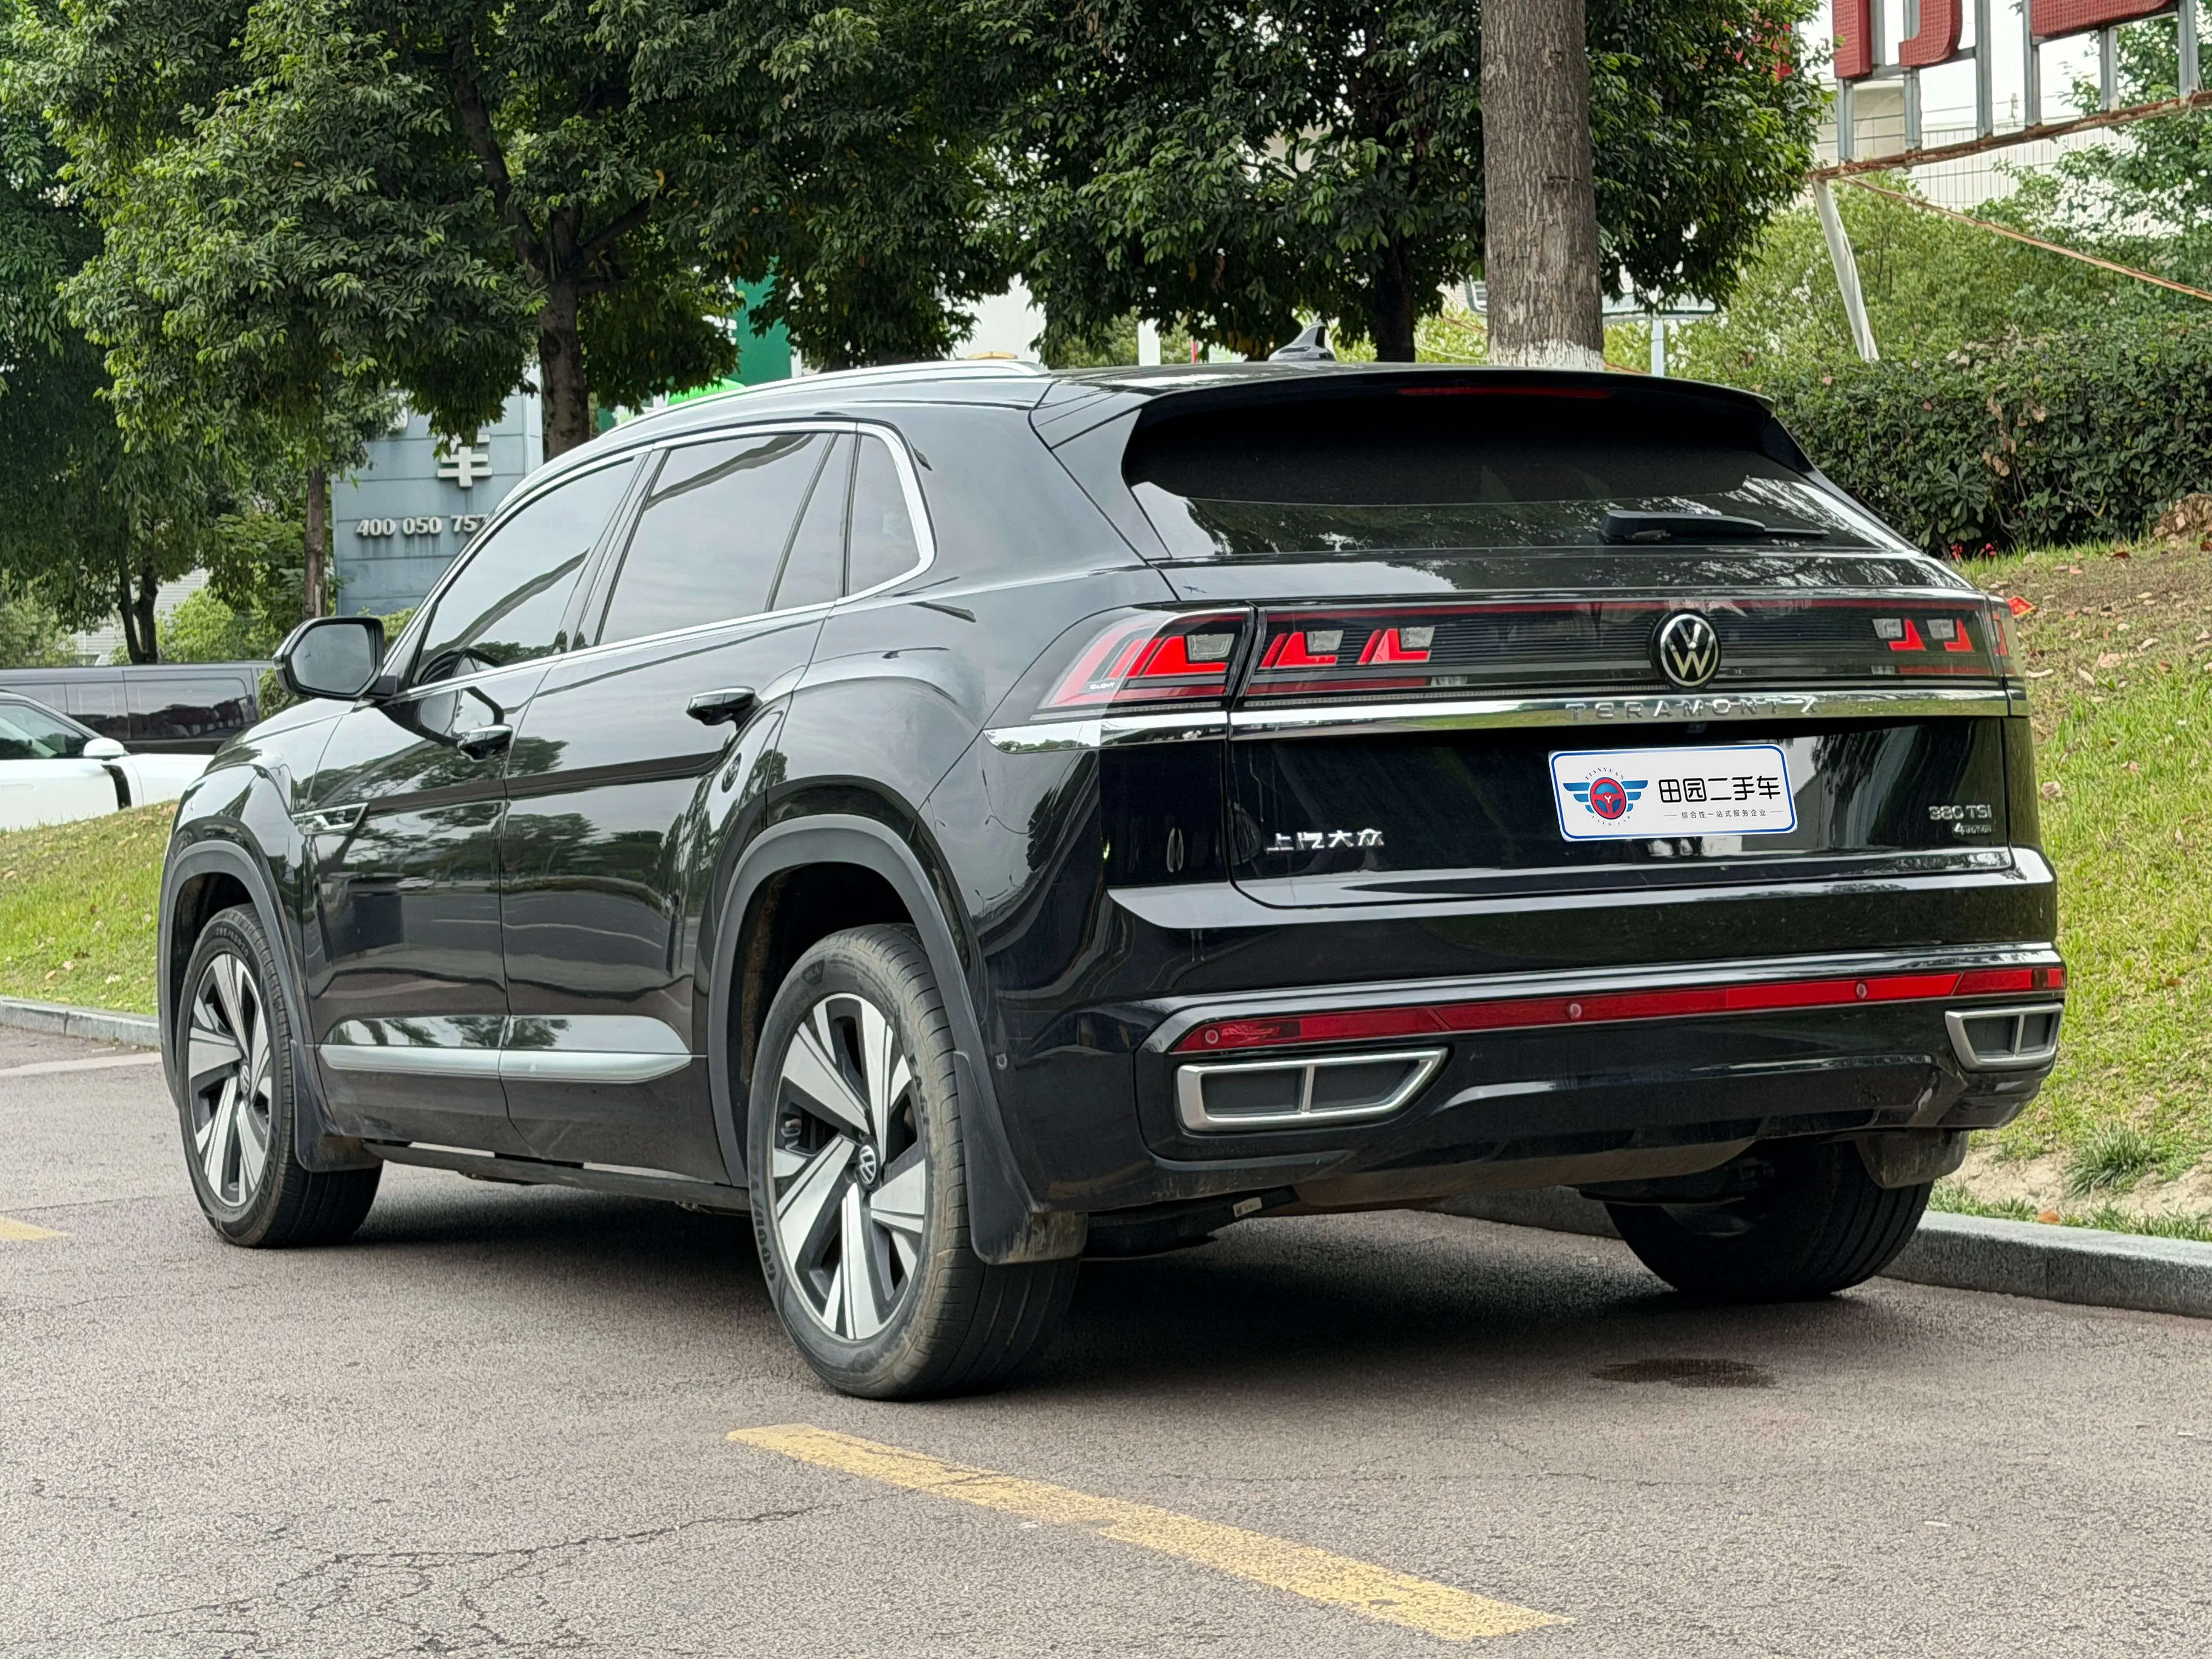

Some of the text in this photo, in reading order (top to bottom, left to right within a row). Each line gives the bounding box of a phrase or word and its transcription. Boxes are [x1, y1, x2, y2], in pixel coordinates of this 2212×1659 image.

[356, 518, 396, 537] 400
[402, 516, 442, 535] 050
[1565, 696, 1818, 721] TERAMONT X
[1658, 776, 1781, 803] 田园二手车
[1681, 809, 1767, 819] 综合性一站式服务企业
[1966, 804, 1992, 819] TSI
[1266, 828, 1385, 853] 上汽大众
